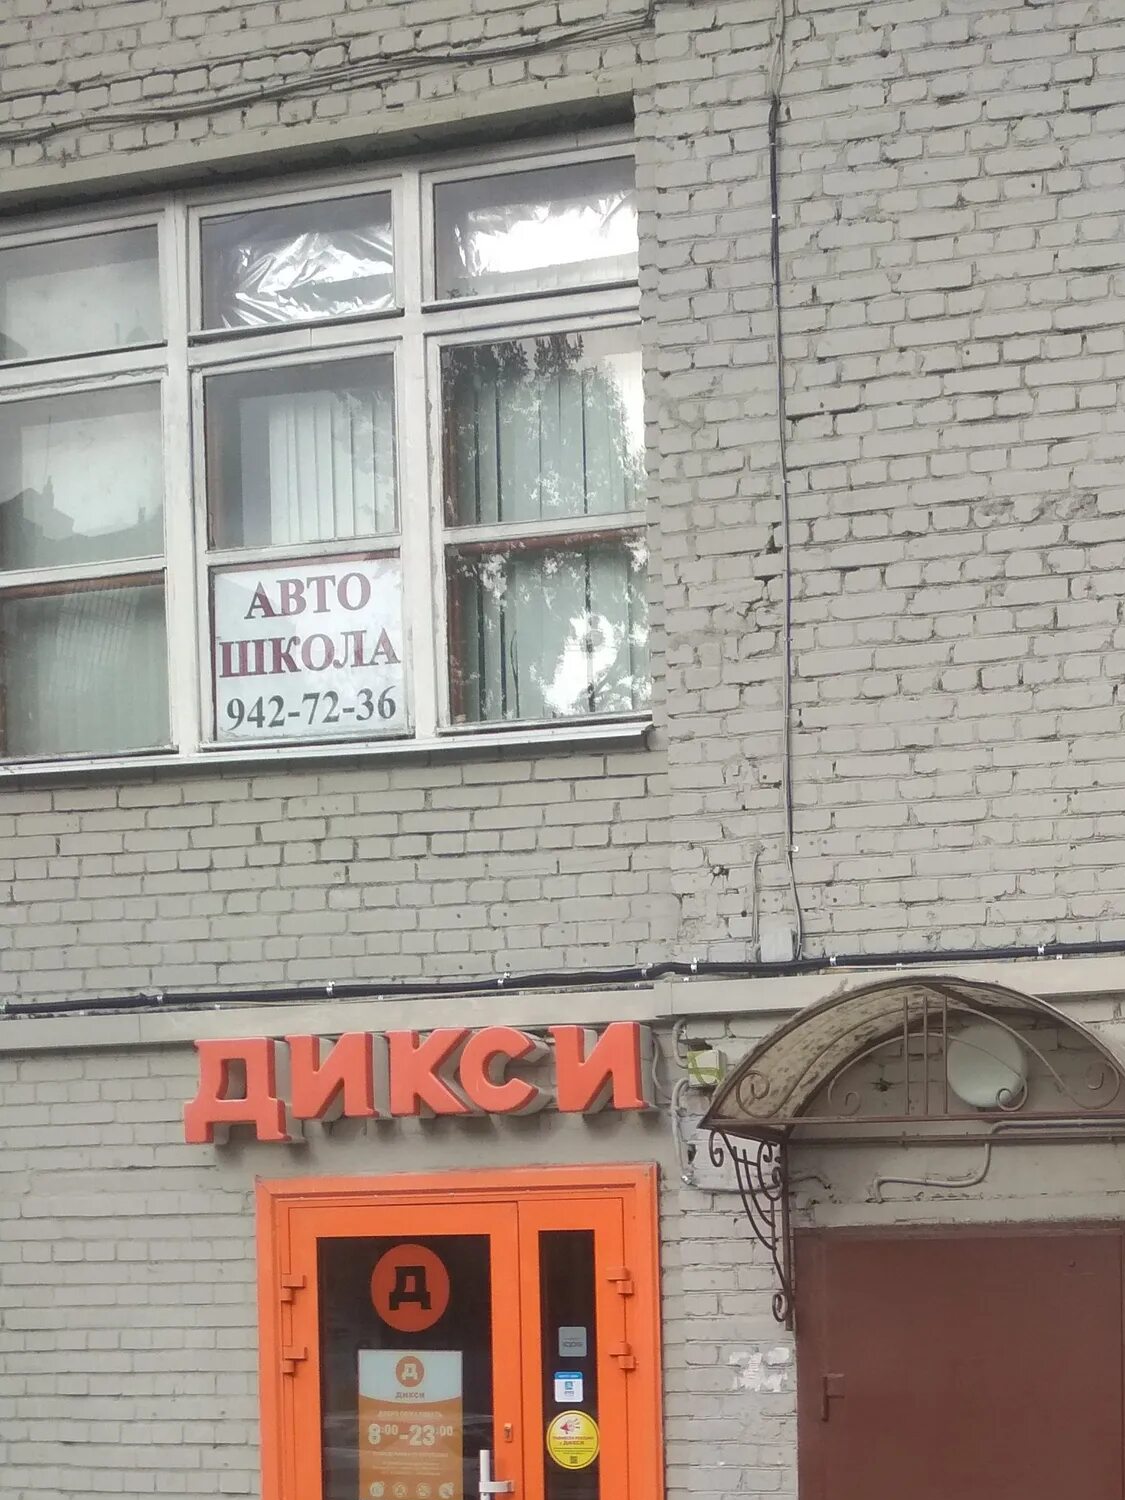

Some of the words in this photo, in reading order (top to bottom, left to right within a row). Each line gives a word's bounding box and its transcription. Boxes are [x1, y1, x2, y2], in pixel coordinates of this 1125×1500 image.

[244, 572, 371, 620] АВТО
[219, 627, 401, 678] ШКОЛА
[226, 685, 396, 731] 942-72-36
[184, 1021, 650, 1144] ДИКСИ
[389, 1266, 432, 1311] Д
